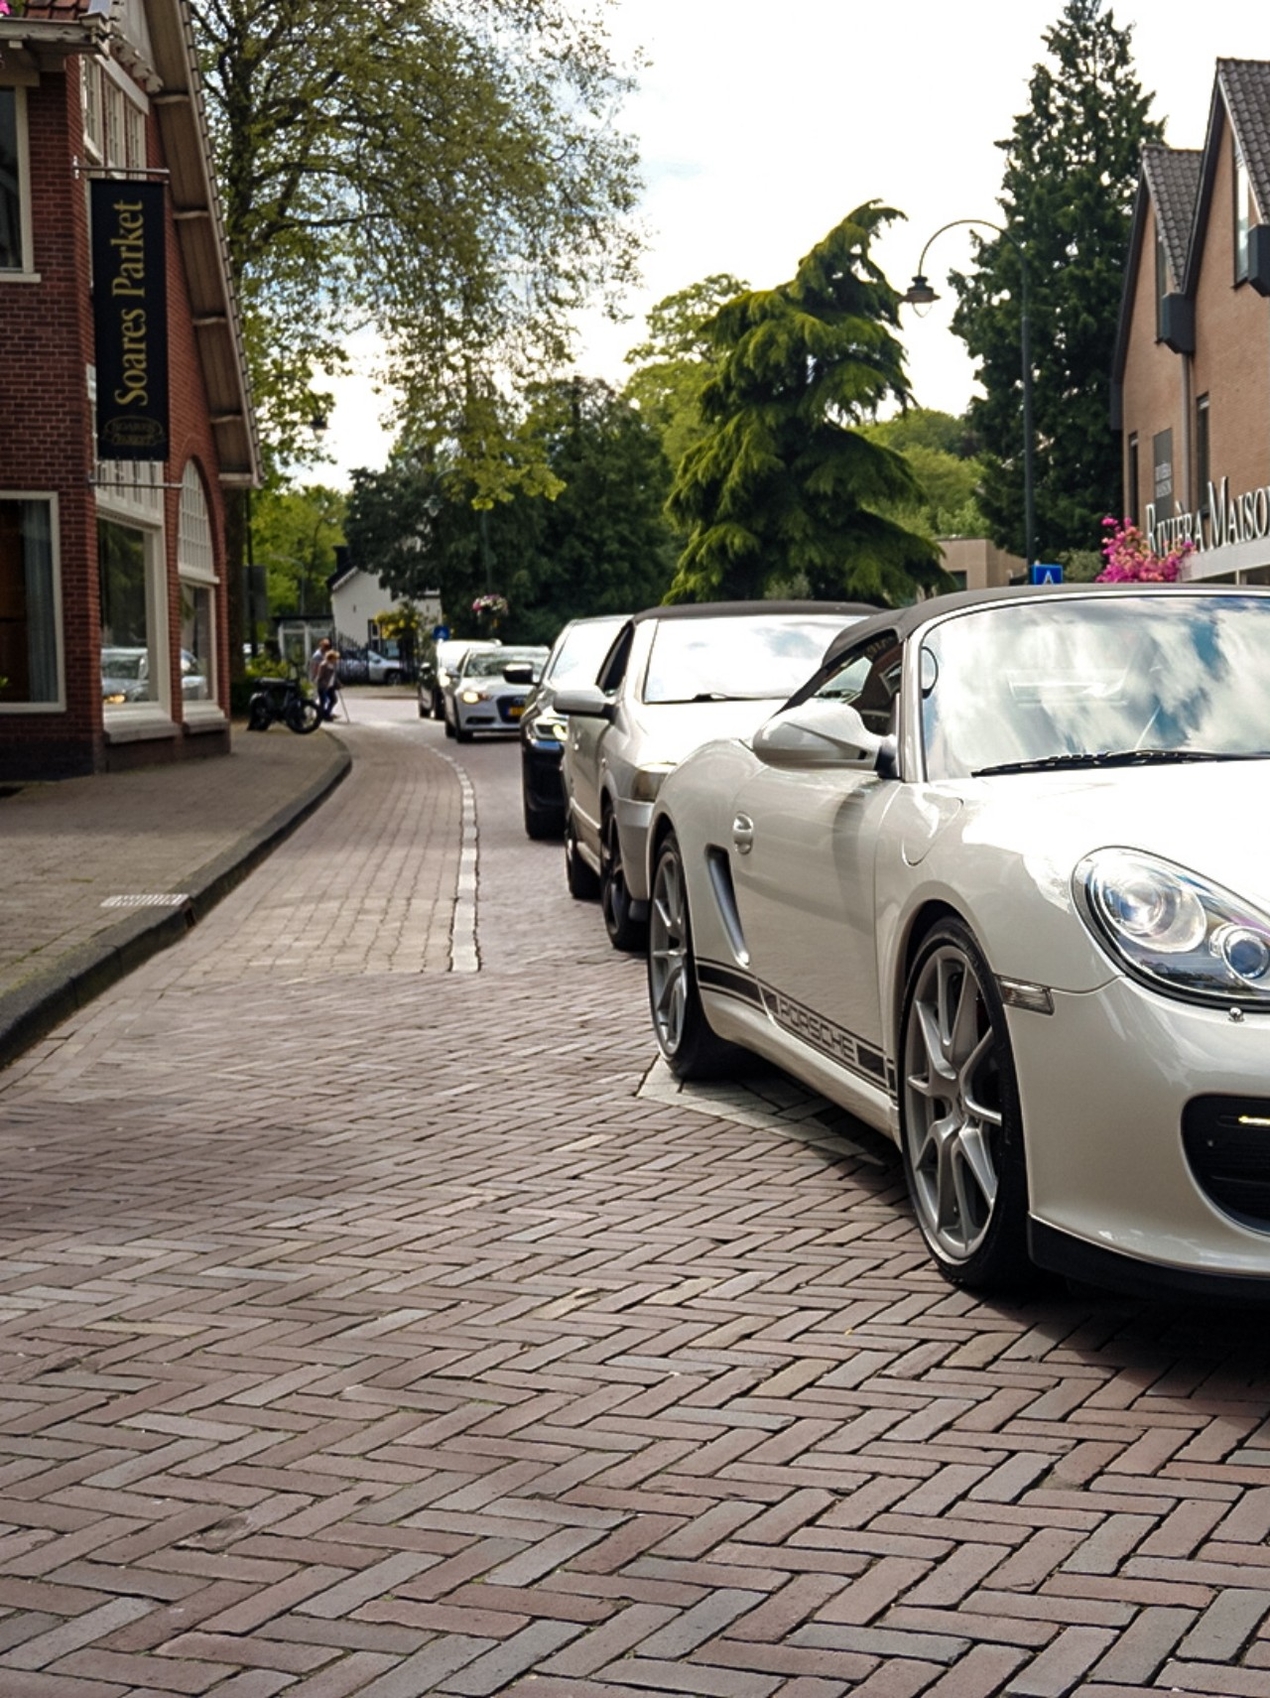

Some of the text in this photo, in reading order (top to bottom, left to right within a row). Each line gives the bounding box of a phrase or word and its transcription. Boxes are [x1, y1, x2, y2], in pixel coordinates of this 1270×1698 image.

[110, 199, 145, 299] Parket
[113, 309, 148, 406] Soares
[779, 998, 856, 1062] PORSCHE
